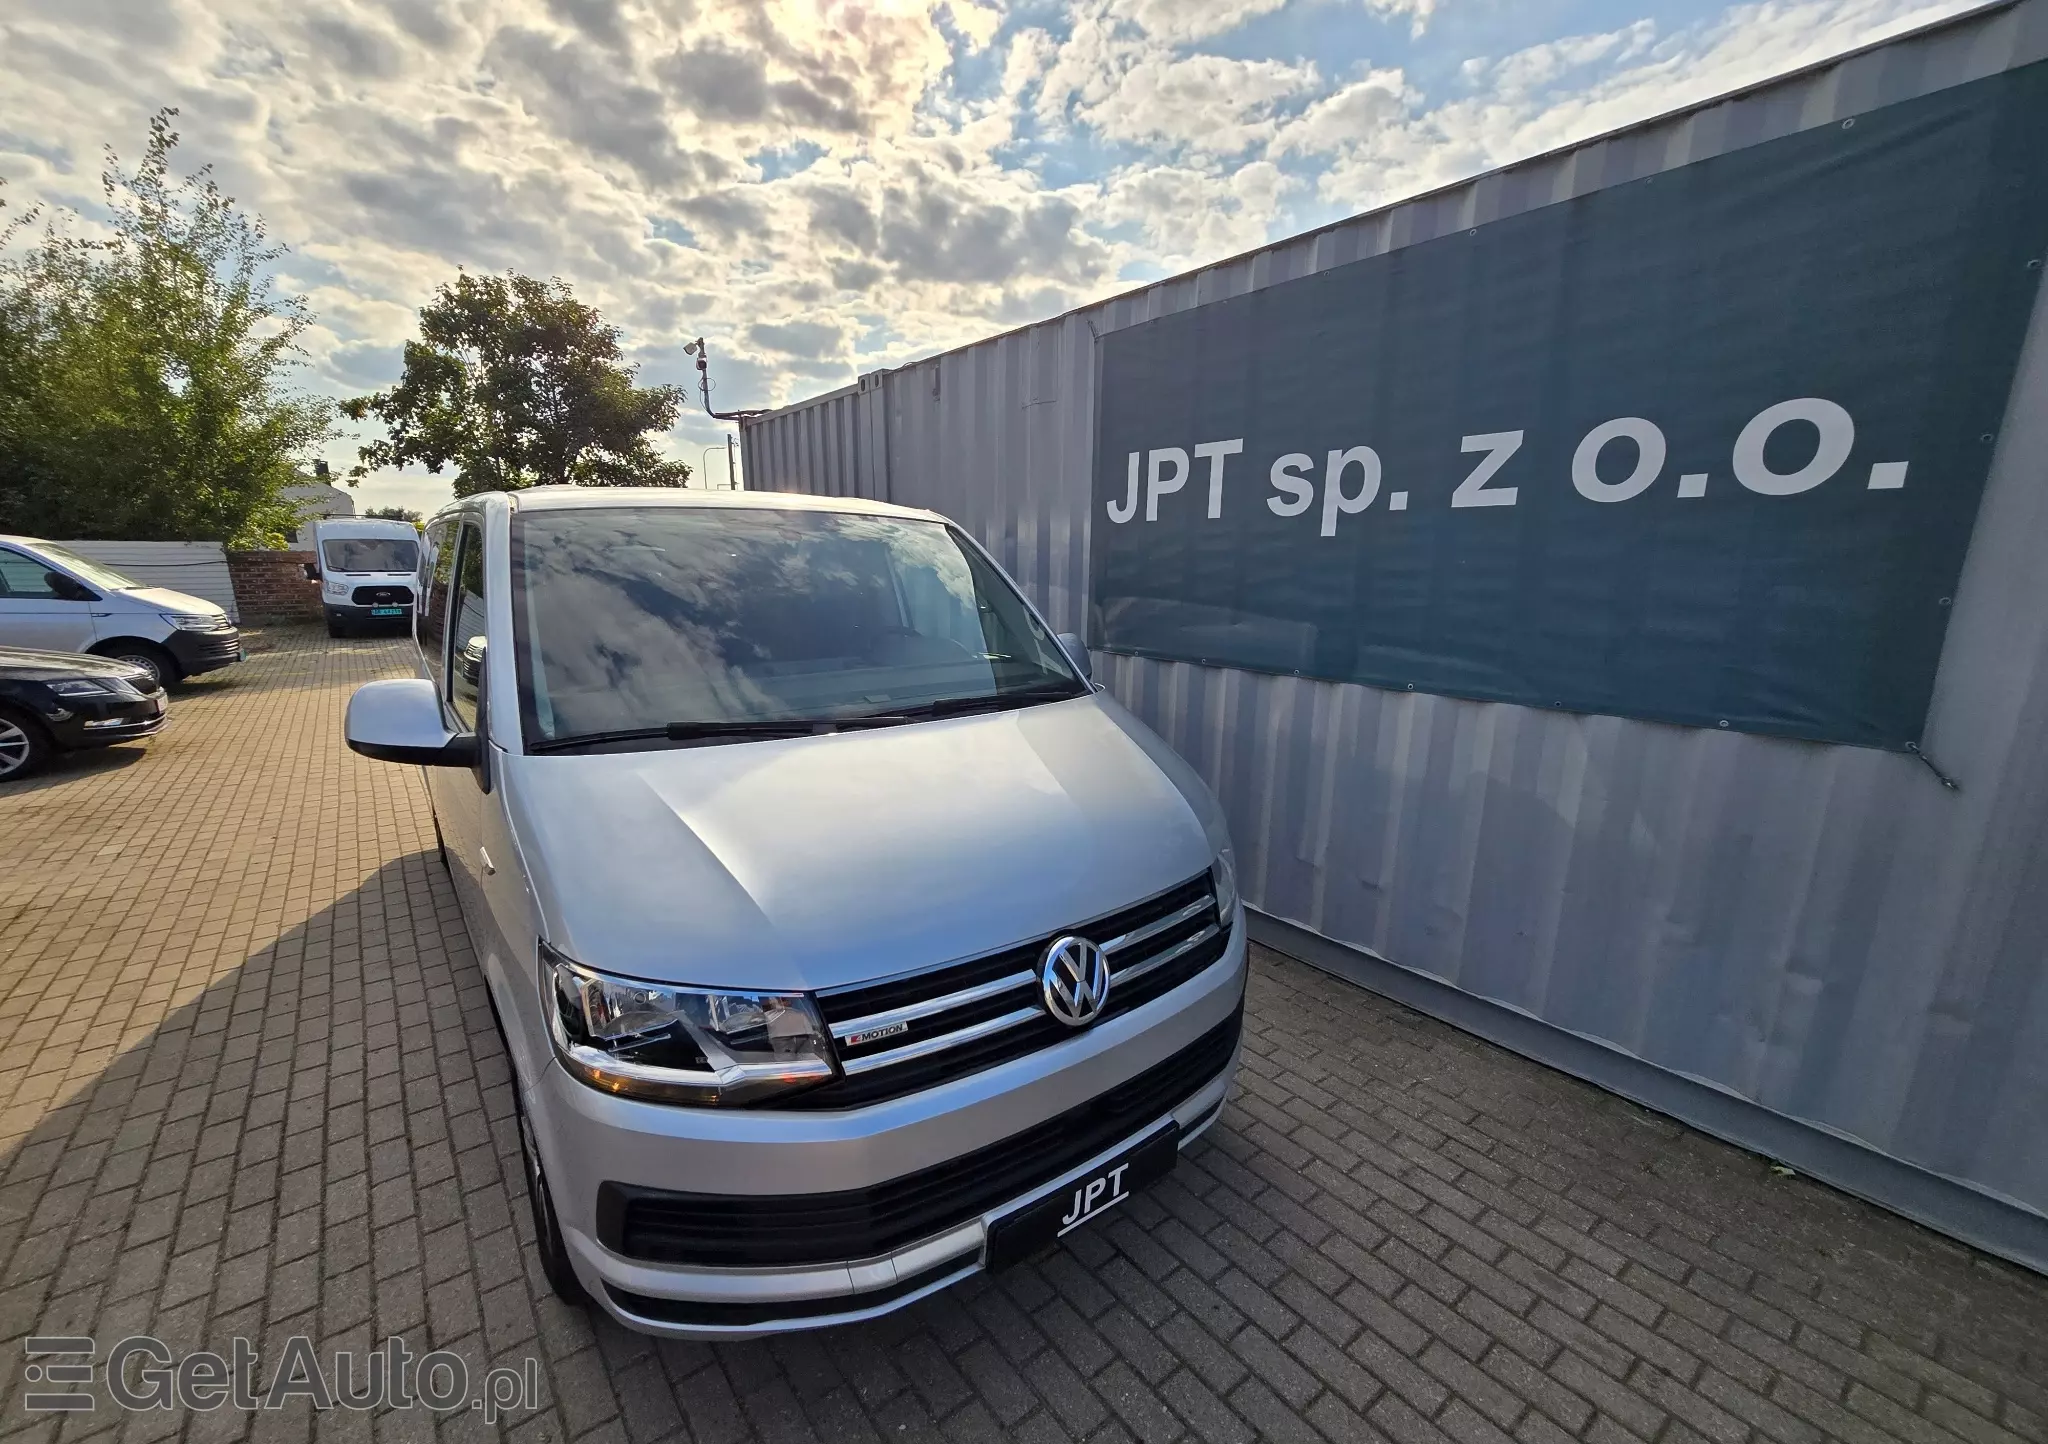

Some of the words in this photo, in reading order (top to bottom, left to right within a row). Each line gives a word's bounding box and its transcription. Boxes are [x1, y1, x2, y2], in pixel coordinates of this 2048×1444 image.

[1106, 438, 1244, 524] JPT
[1266, 446, 1409, 537] sp.
[1450, 430, 1524, 508] z
[1572, 398, 1909, 503] o.o.
[1061, 1163, 1129, 1225] JPT
